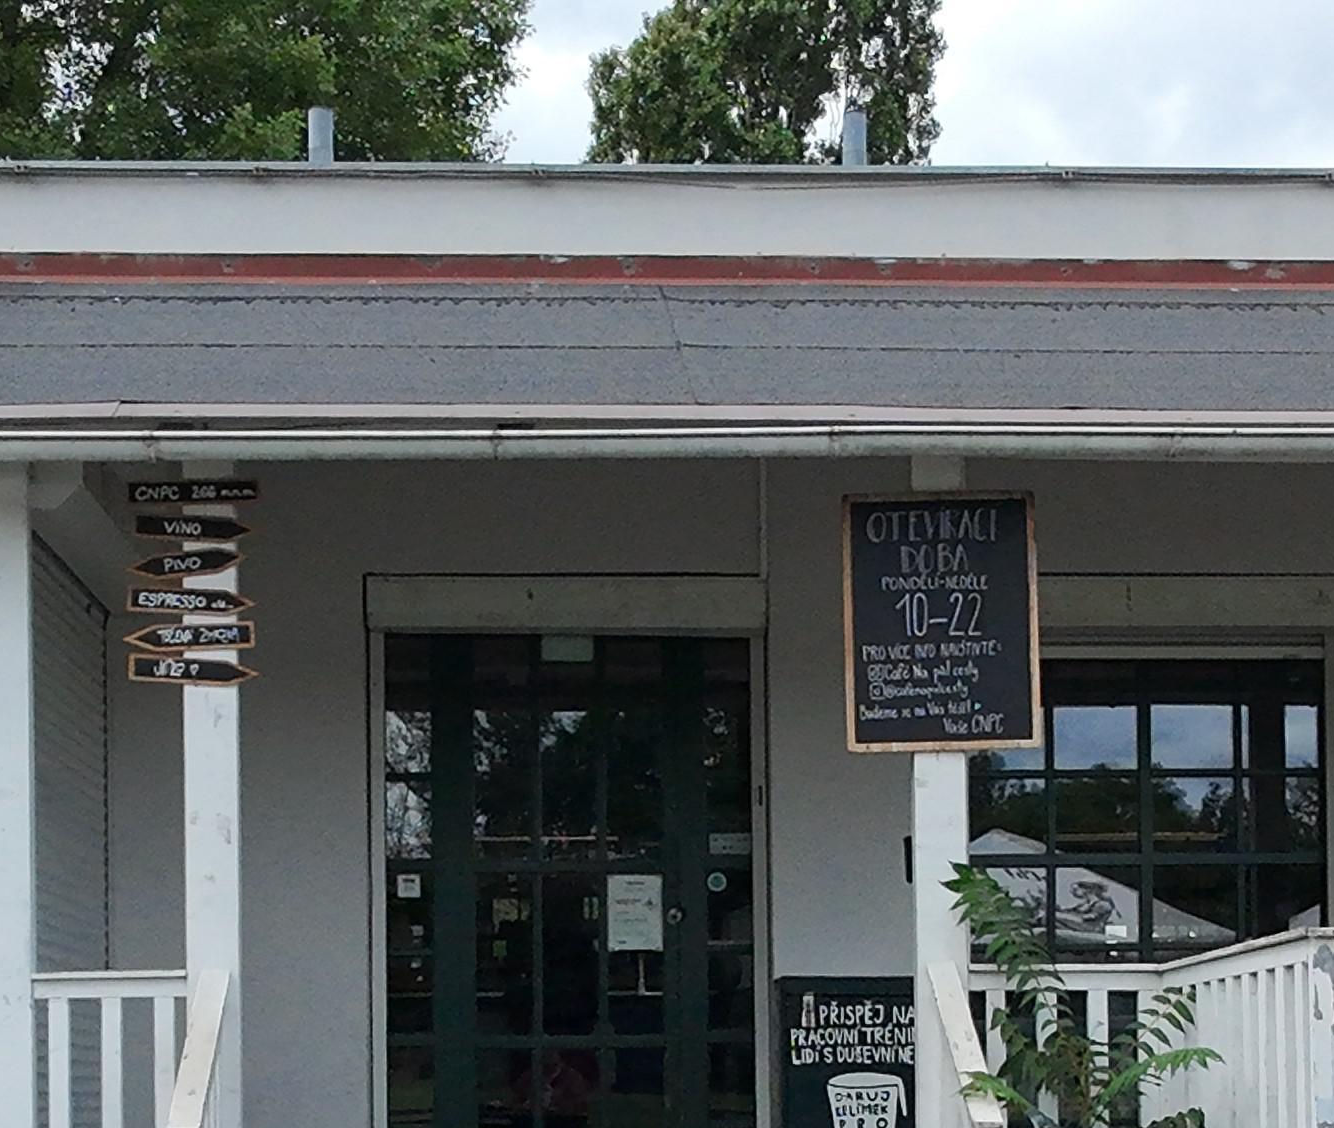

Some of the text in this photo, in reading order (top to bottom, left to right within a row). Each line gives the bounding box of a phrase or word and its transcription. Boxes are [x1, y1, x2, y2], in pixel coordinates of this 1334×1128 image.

[134, 485, 180, 501] CNPC
[163, 556, 202, 572] PIVO
[900, 542, 969, 573] DOBA
[138, 591, 207, 609] ESPRESSO
[895, 592, 983, 637] 10-22
[971, 712, 1005, 735] CNPC
[818, 999, 915, 1026] PŘISPĚJ NA
[790, 1023, 861, 1047] PRACOVNÍ
[823, 1046, 834, 1064] S
[834, 1090, 891, 1102] DARUJ
